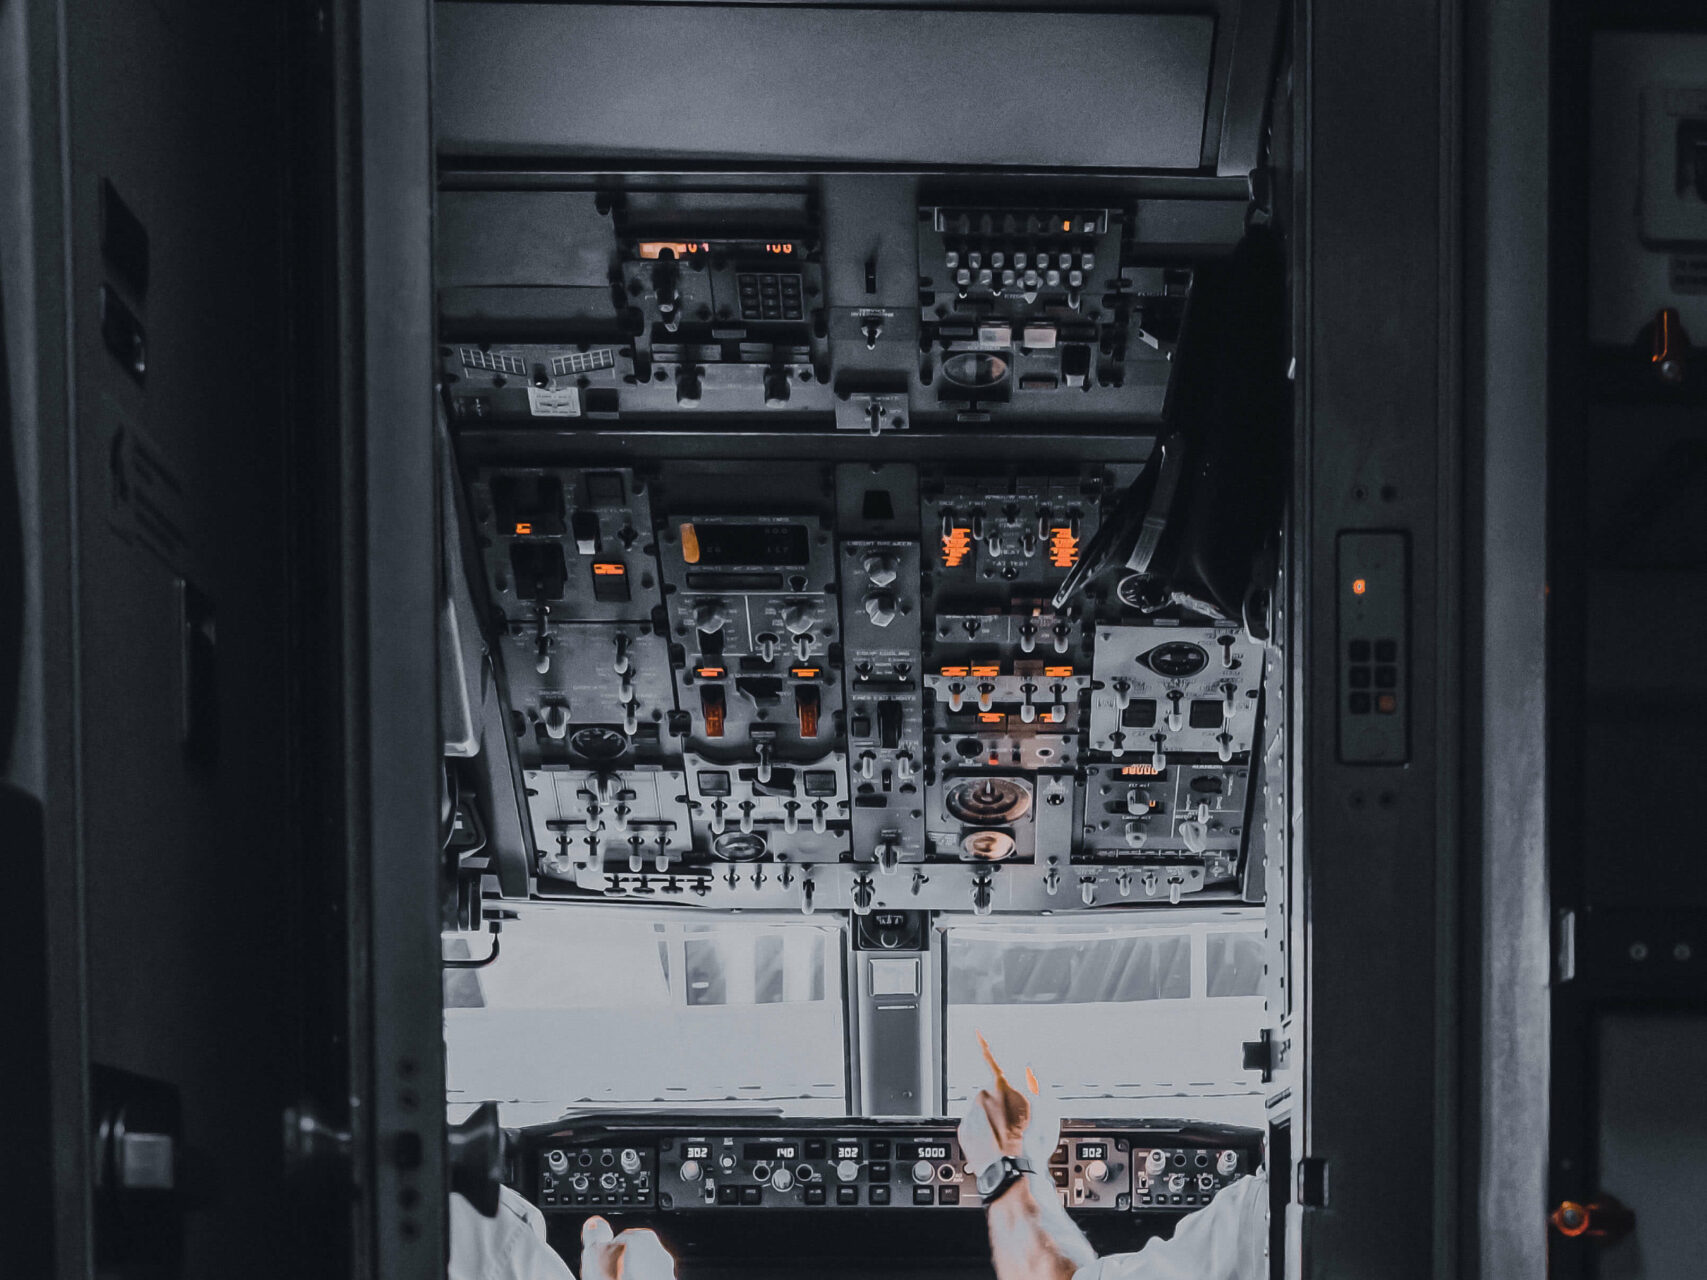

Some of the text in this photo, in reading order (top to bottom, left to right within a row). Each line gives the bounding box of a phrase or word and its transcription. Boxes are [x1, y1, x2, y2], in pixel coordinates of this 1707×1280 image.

[687, 1147, 708, 1158] 302
[776, 1147, 795, 1158] 140
[838, 1147, 859, 1158] 302
[917, 1147, 946, 1158] 5000
[1082, 1147, 1103, 1158] 302
